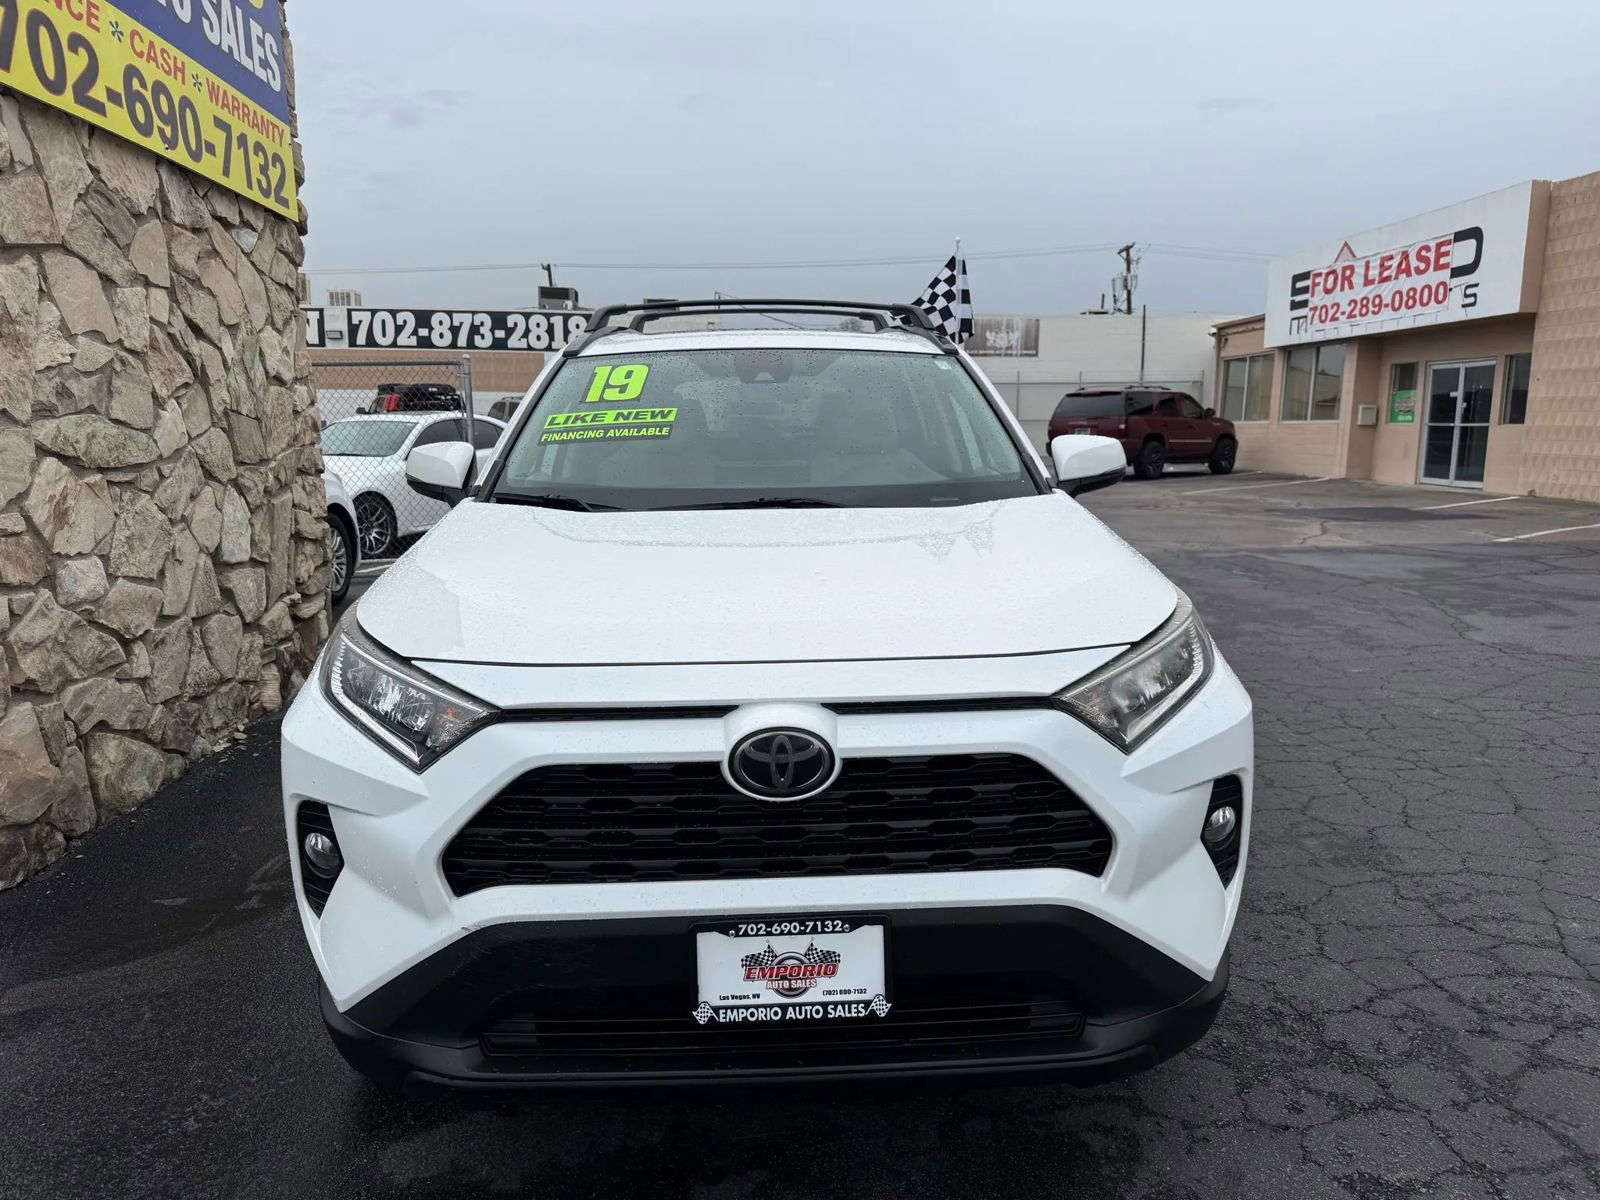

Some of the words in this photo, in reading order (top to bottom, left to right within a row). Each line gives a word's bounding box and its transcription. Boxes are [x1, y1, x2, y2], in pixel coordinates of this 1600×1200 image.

[200, 0, 281, 92] SALES
[129, 28, 186, 86] CASH
[205, 77, 285, 148] WARRANTY
[1310, 263, 1356, 298] FOR
[1363, 238, 1453, 287] LEASE
[1309, 281, 1449, 325] 702-289-0800
[585, 364, 649, 402] 19
[546, 412, 608, 427] LIKE
[612, 409, 674, 421] NEW
[540, 430, 605, 442] FINANCING
[606, 427, 671, 440] AVAILABLE
[738, 920, 843, 936] 702-690-7132
[743, 963, 839, 981] EMPORIO
[766, 980, 790, 990] AUTO
[791, 978, 817, 989] SALES
[719, 1006, 782, 1023] EMPORIO
[785, 1005, 823, 1020] AUTO
[827, 1003, 866, 1018] SALES
